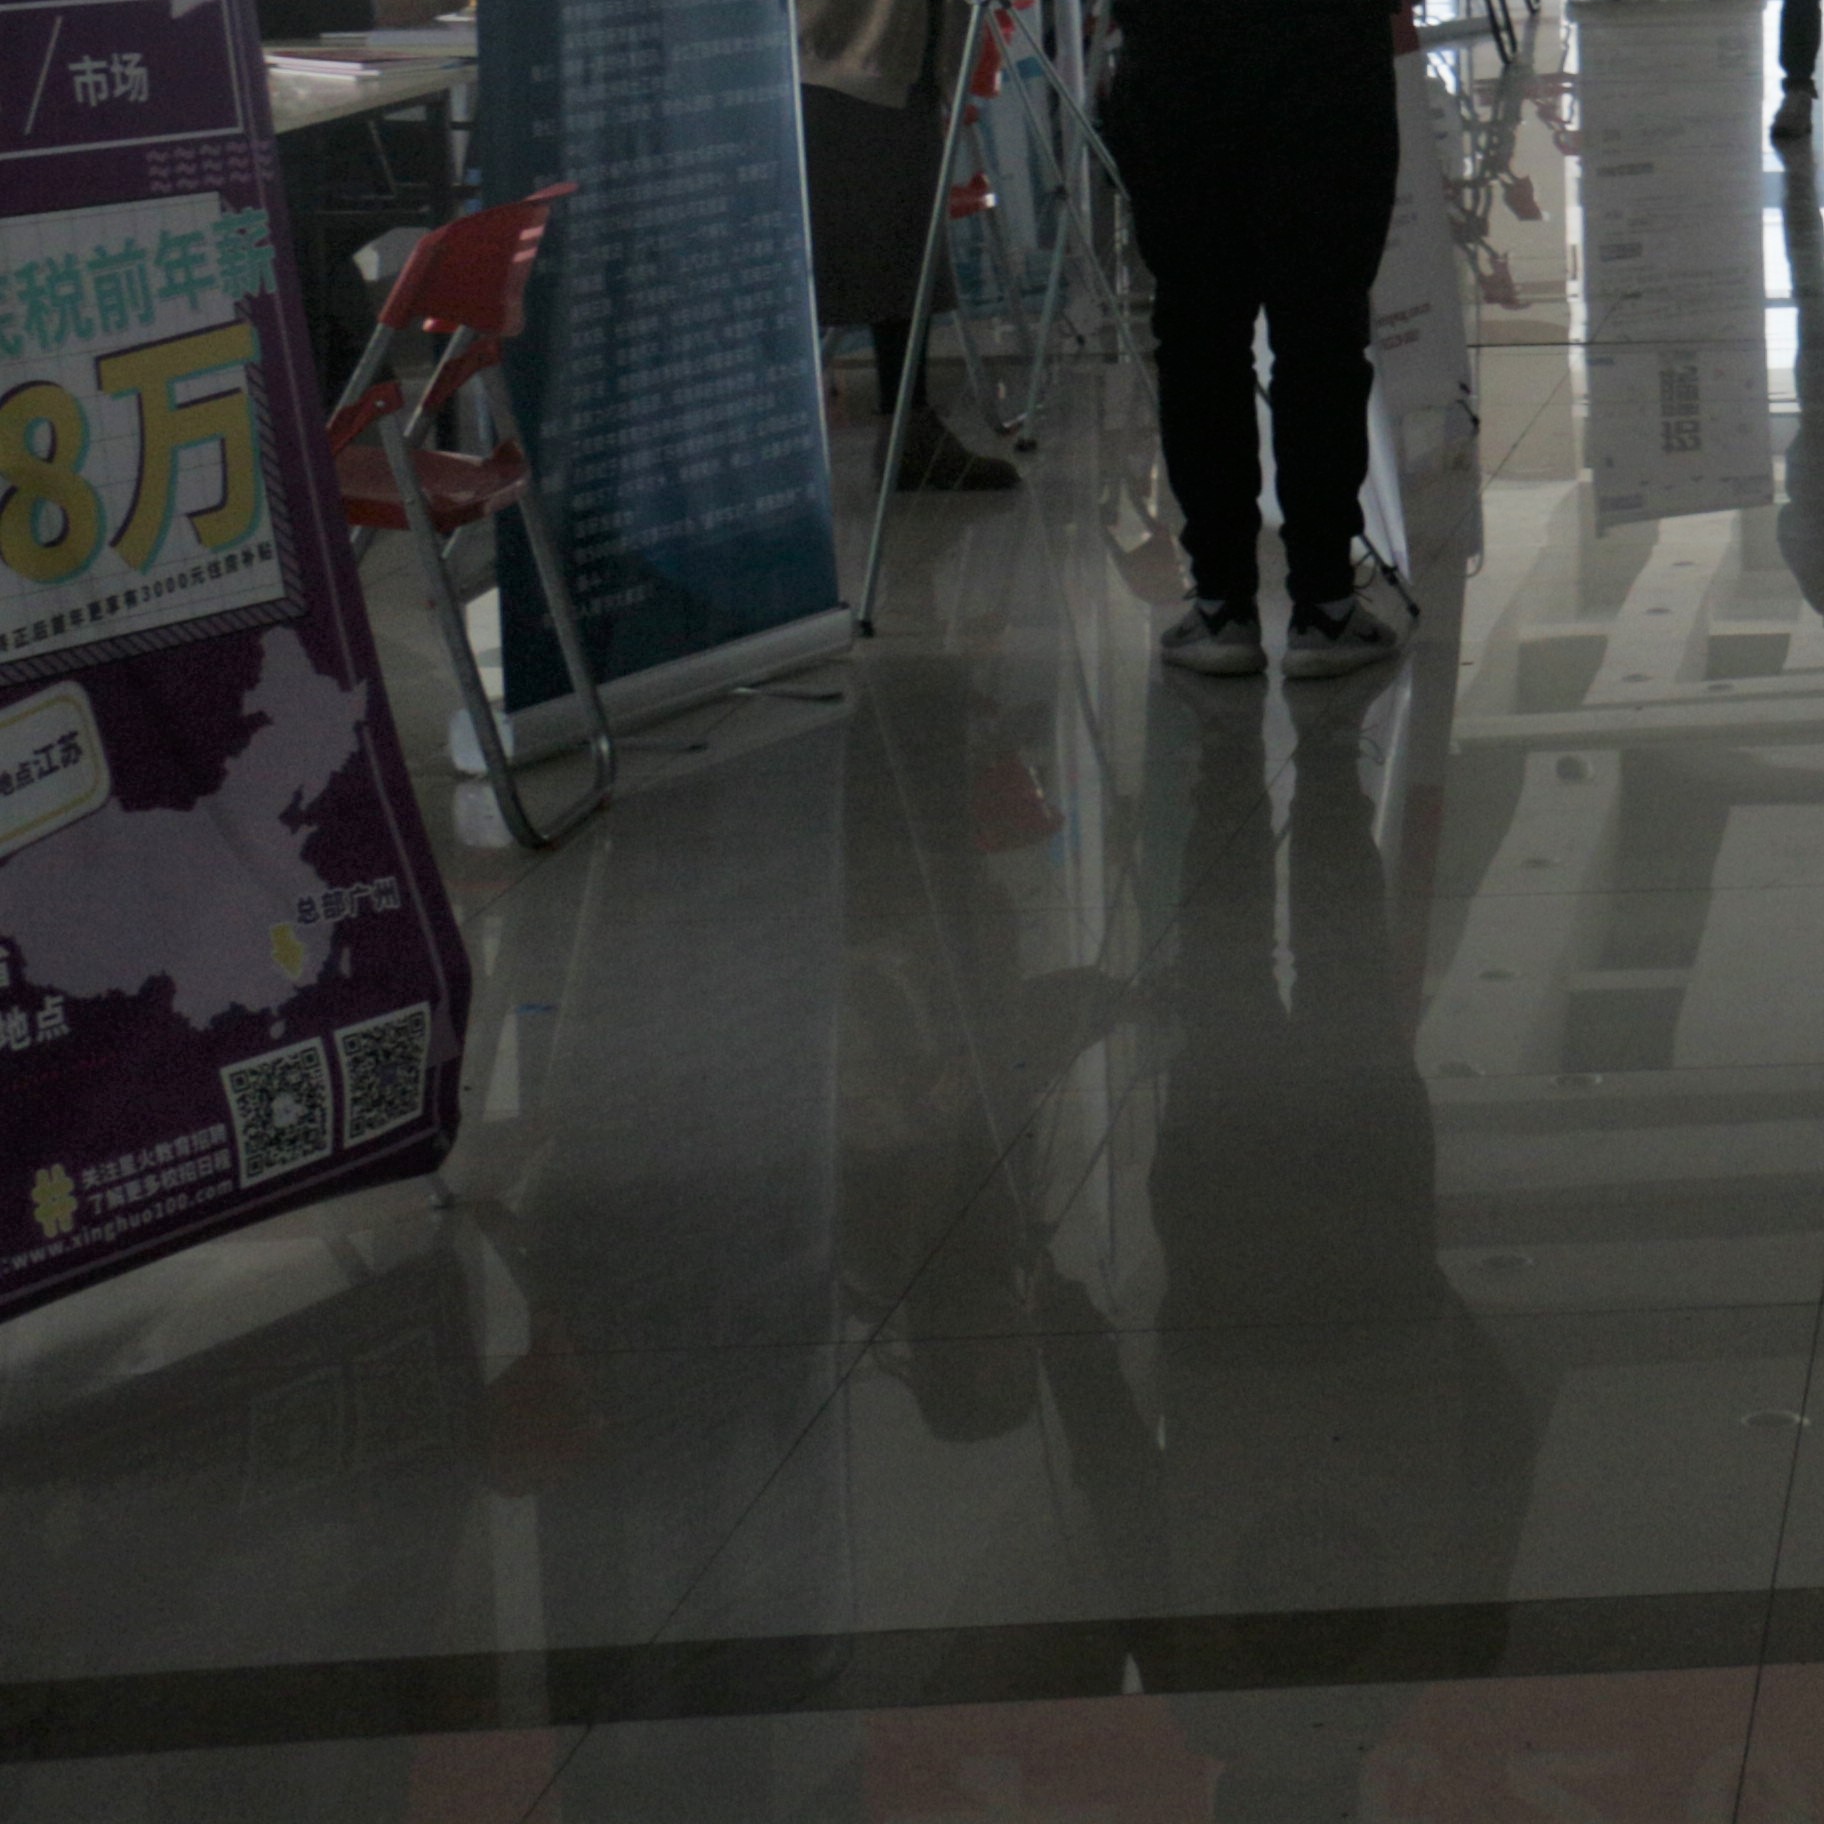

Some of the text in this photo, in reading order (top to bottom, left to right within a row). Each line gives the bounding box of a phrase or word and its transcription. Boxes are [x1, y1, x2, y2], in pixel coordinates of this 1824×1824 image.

[68, 51, 151, 109] 市场
[296, 875, 402, 925] 总部广州
